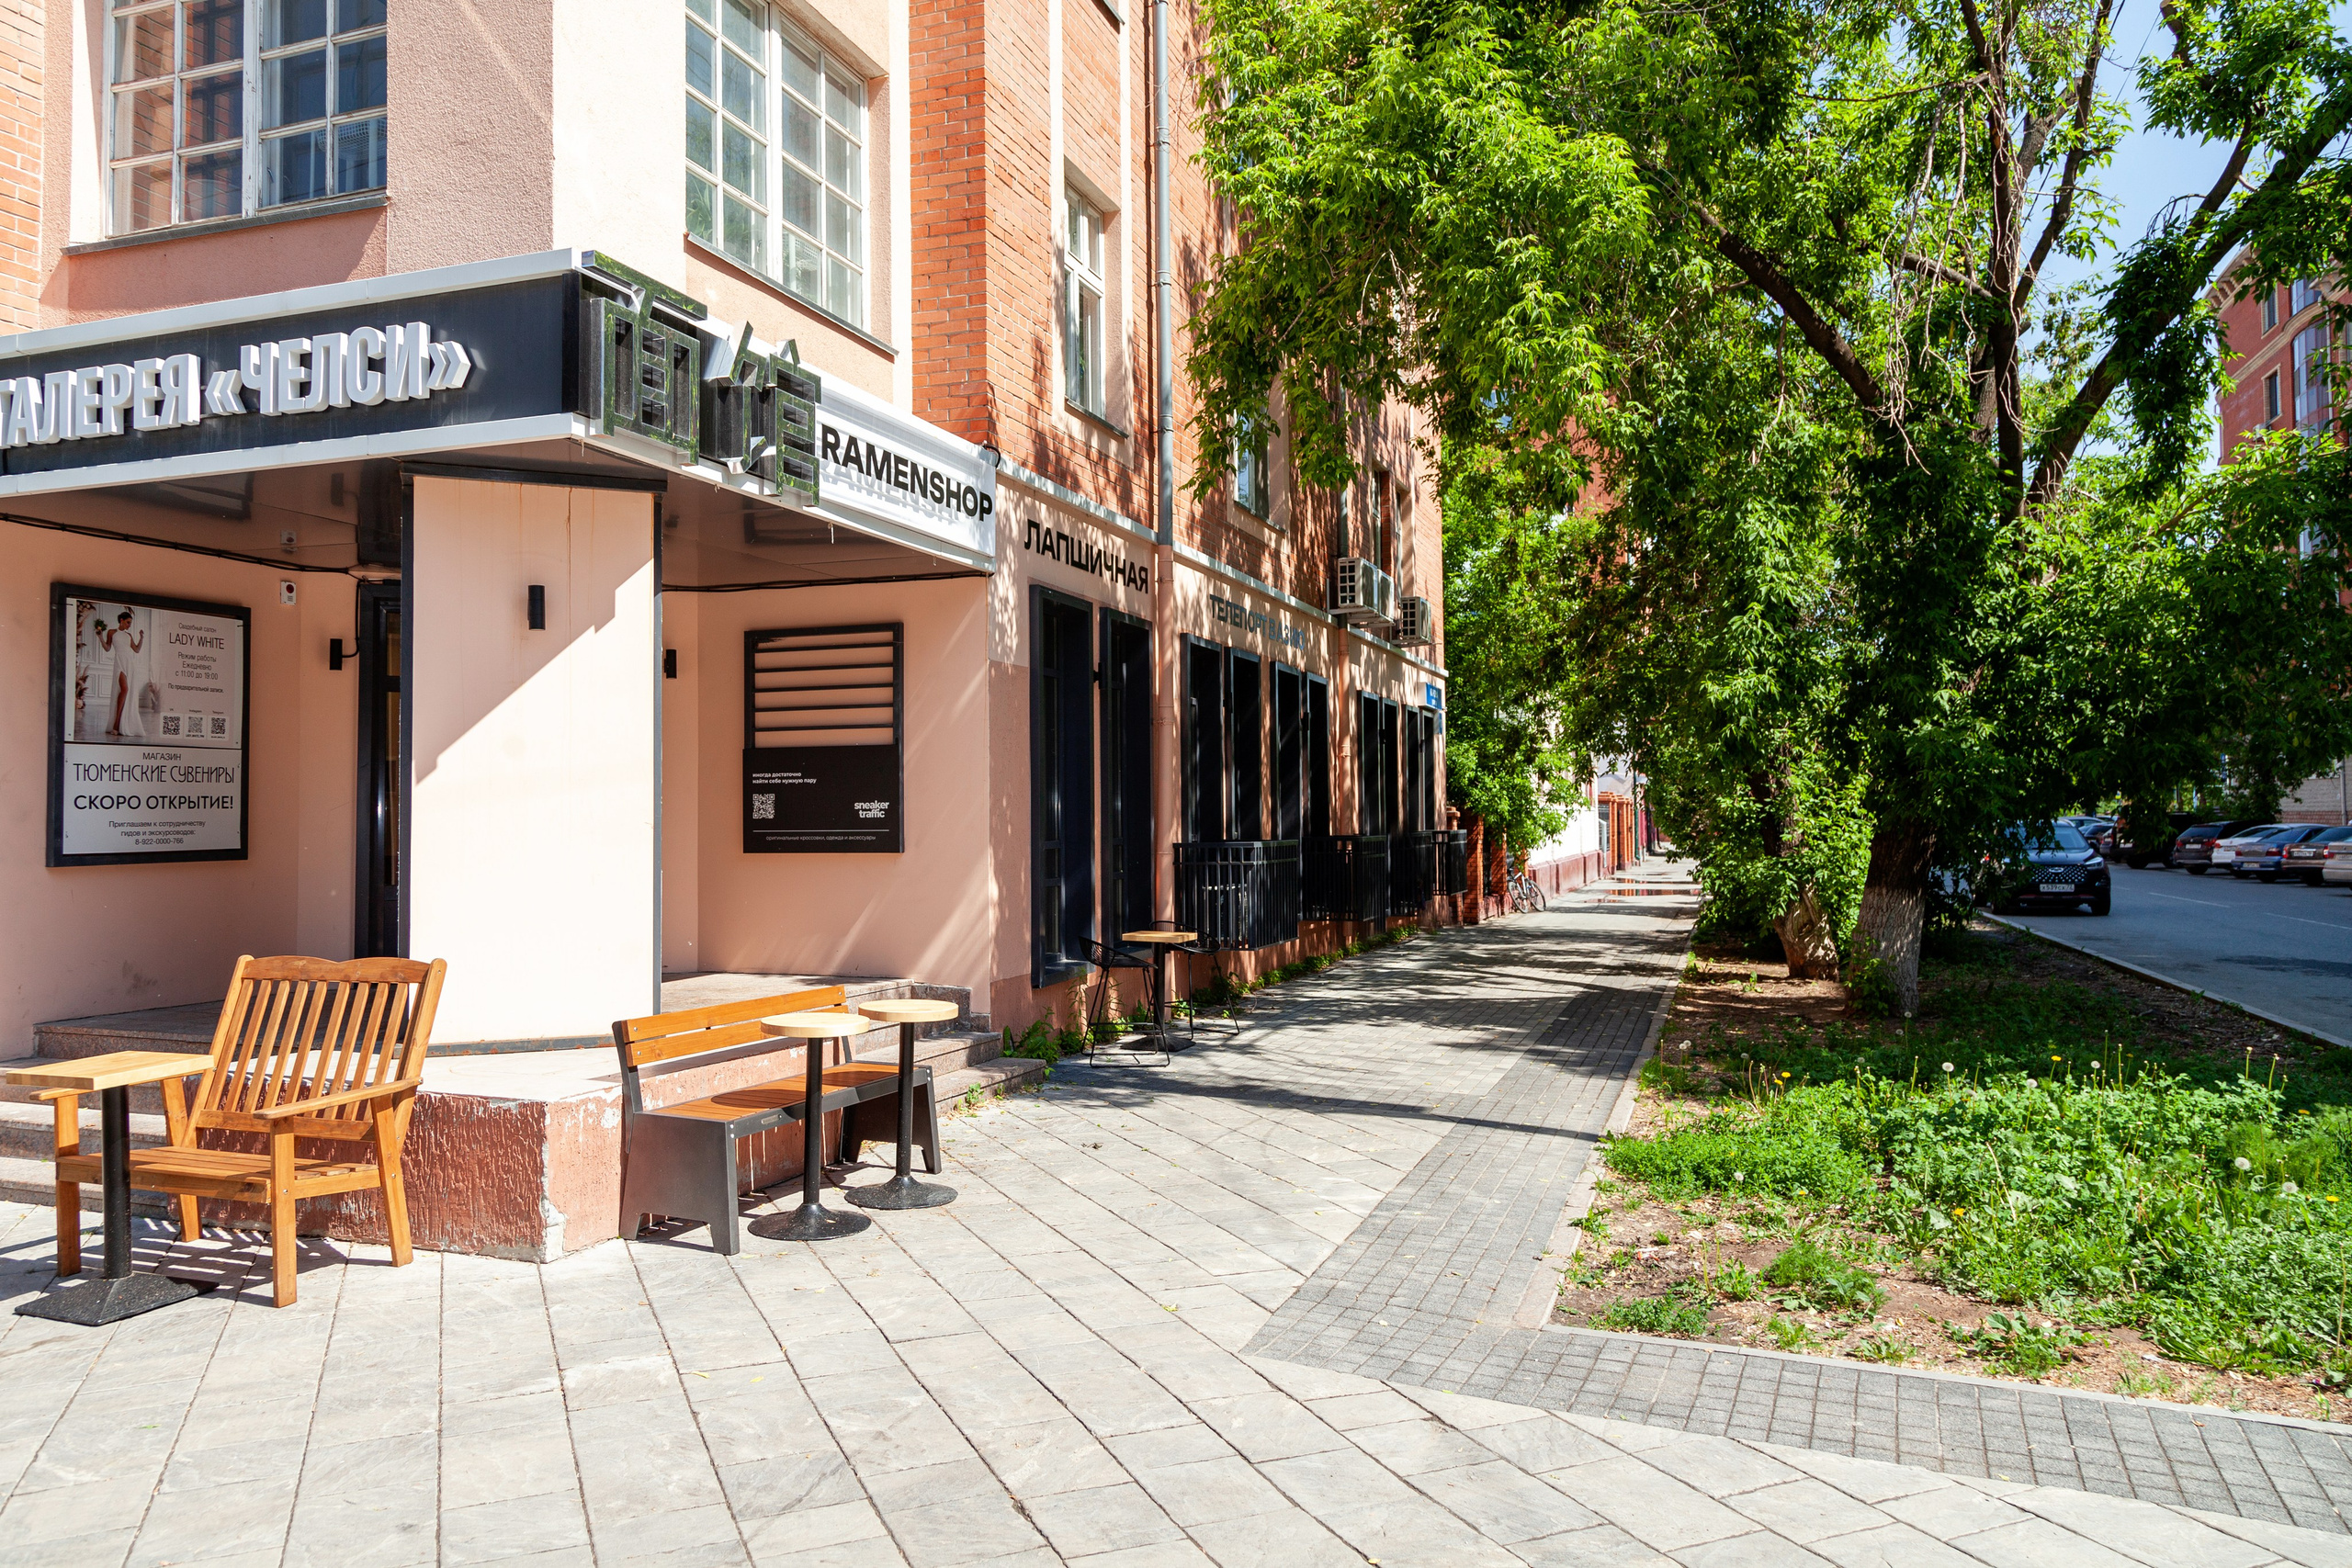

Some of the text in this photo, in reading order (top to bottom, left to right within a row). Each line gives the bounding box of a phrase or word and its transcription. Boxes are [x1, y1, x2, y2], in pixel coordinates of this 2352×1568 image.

[204, 321, 471, 416] «ЧЕЛСИ»
[821, 423, 993, 522] RAMENSHOP
[1024, 519, 1148, 594] ЛАПШИЧНАЯ
[179, 623, 202, 631] Свадебный
[1210, 594, 1304, 650] ТЕЛЕПОРТ В АЗИЮ
[169, 633, 224, 649] LADY WHITE
[182, 661, 212, 671] Ежедневно
[143, 752, 181, 761] МАГАЗИН
[73, 763, 234, 783] ТЮМЕНСКИЕ СУВЕНИРЫ
[74, 795, 233, 809] СКОРО ОТКРЫТИЕ!
[854, 800, 890, 809] sneaker
[859, 809, 885, 818] traffic
